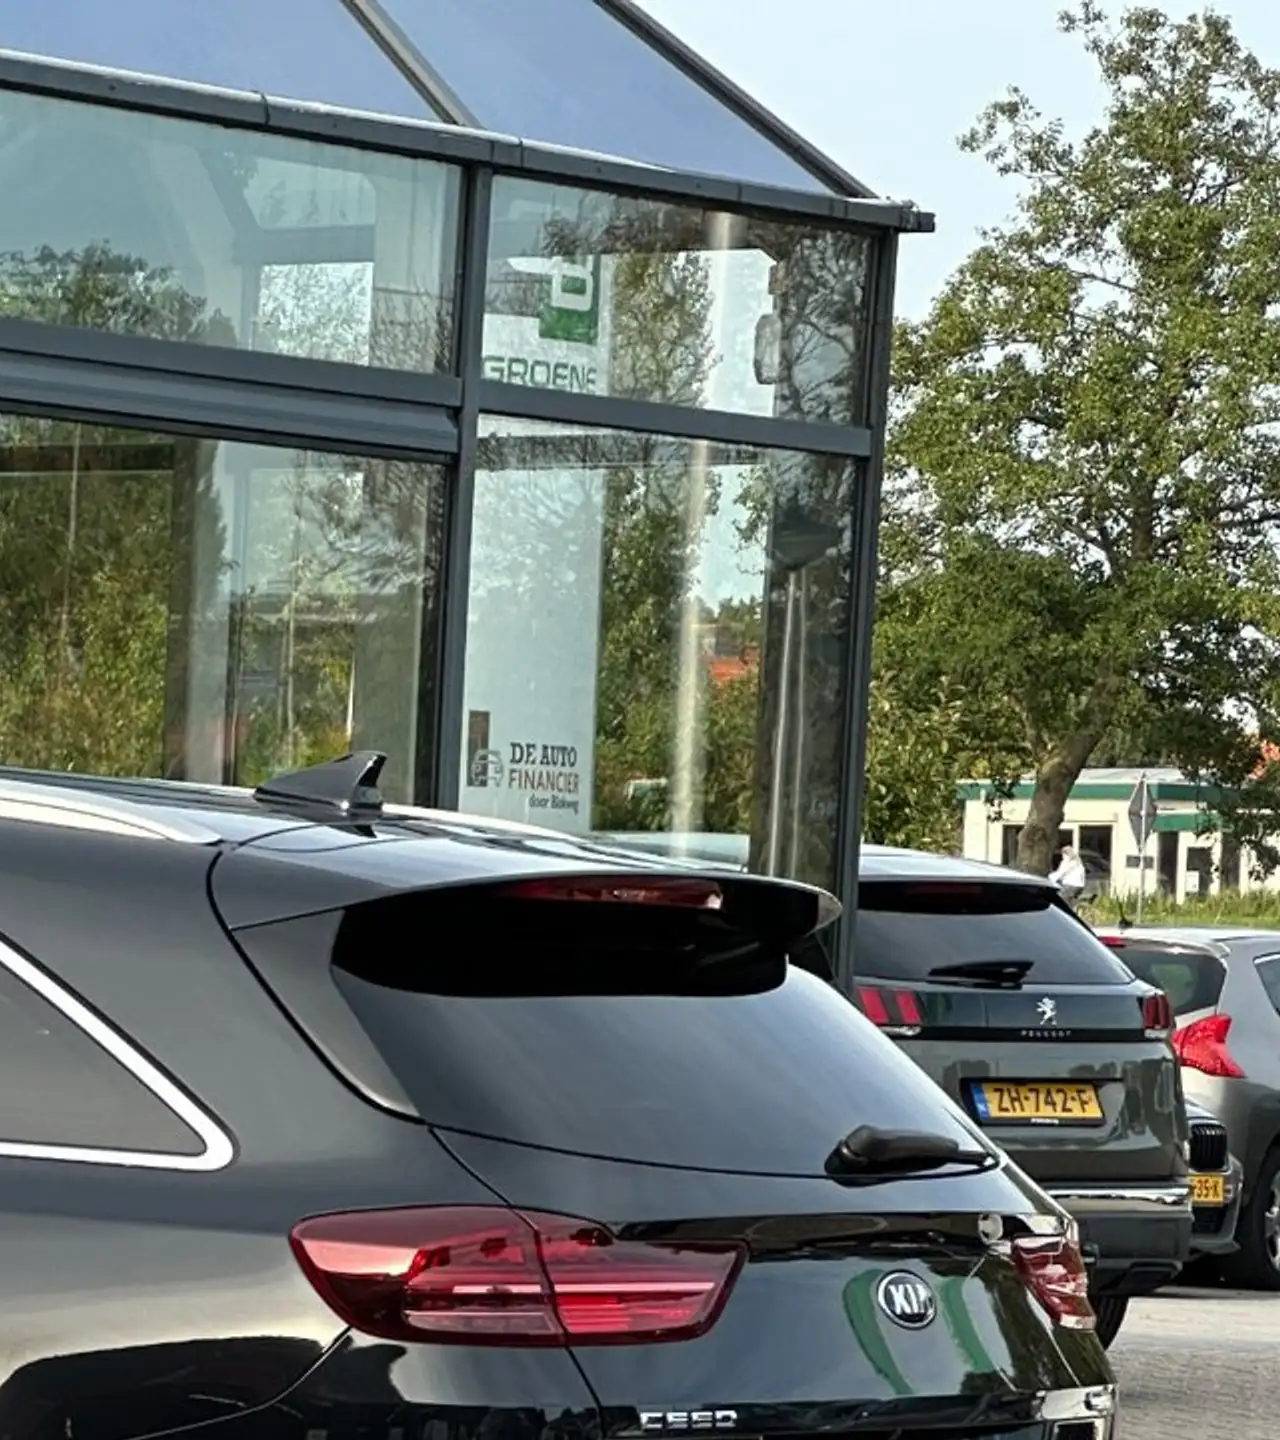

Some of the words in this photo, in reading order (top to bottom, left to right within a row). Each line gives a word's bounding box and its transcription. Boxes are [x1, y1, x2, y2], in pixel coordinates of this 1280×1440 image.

[509, 741, 537, 766] DE
[539, 743, 578, 769] AUTO
[507, 767, 580, 795] FINANCIER
[639, 1409, 739, 1430] CEED
